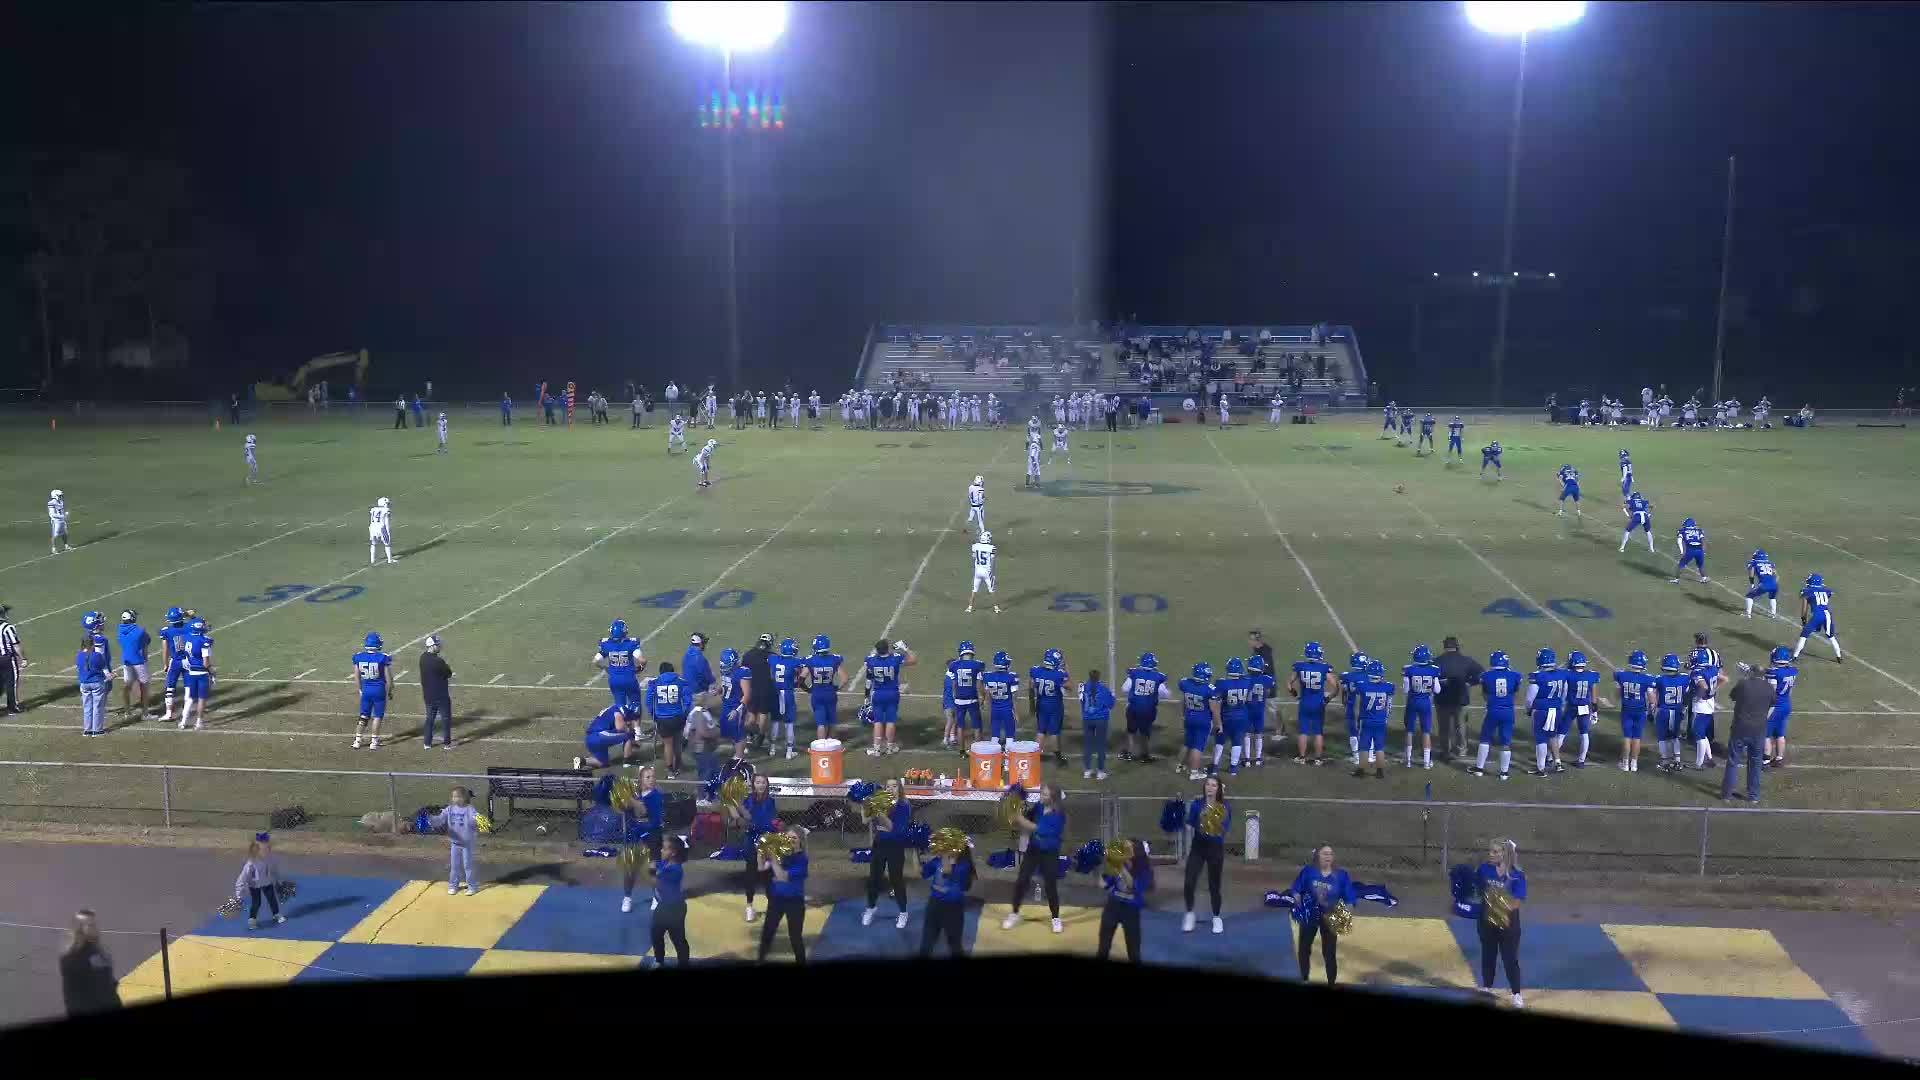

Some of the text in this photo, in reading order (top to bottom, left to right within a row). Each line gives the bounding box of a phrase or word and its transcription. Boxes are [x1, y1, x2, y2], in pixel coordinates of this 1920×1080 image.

[371, 510, 381, 522] 14
[976, 549, 987, 565] 15
[238, 584, 365, 603] 30
[634, 588, 757, 609] 40
[1052, 592, 1168, 612] 50
[1814, 591, 1829, 606] 10
[1480, 597, 1614, 619] 40
[609, 651, 629, 667] 56
[358, 662, 379, 680] 50
[775, 664, 786, 683] 2
[813, 667, 833, 684] 53
[873, 666, 895, 683] 54
[957, 668, 973, 687] 15
[1301, 671, 1322, 690] 42
[987, 681, 1009, 700] 22
[1036, 679, 1056, 697] 72
[1411, 675, 1433, 693] 82
[1495, 678, 1507, 697] 8
[1547, 679, 1563, 699] 71
[1576, 680, 1589, 699] 11
[1623, 681, 1641, 700] 14
[657, 684, 679, 704] 58
[1184, 692, 1205, 711] 65
[1227, 688, 1249, 704] 64
[1365, 691, 1387, 711] 73
[1664, 686, 1683, 704] 21
[819, 757, 829, 769] G
[980, 760, 991, 771] G
[1018, 759, 1028, 770] G
